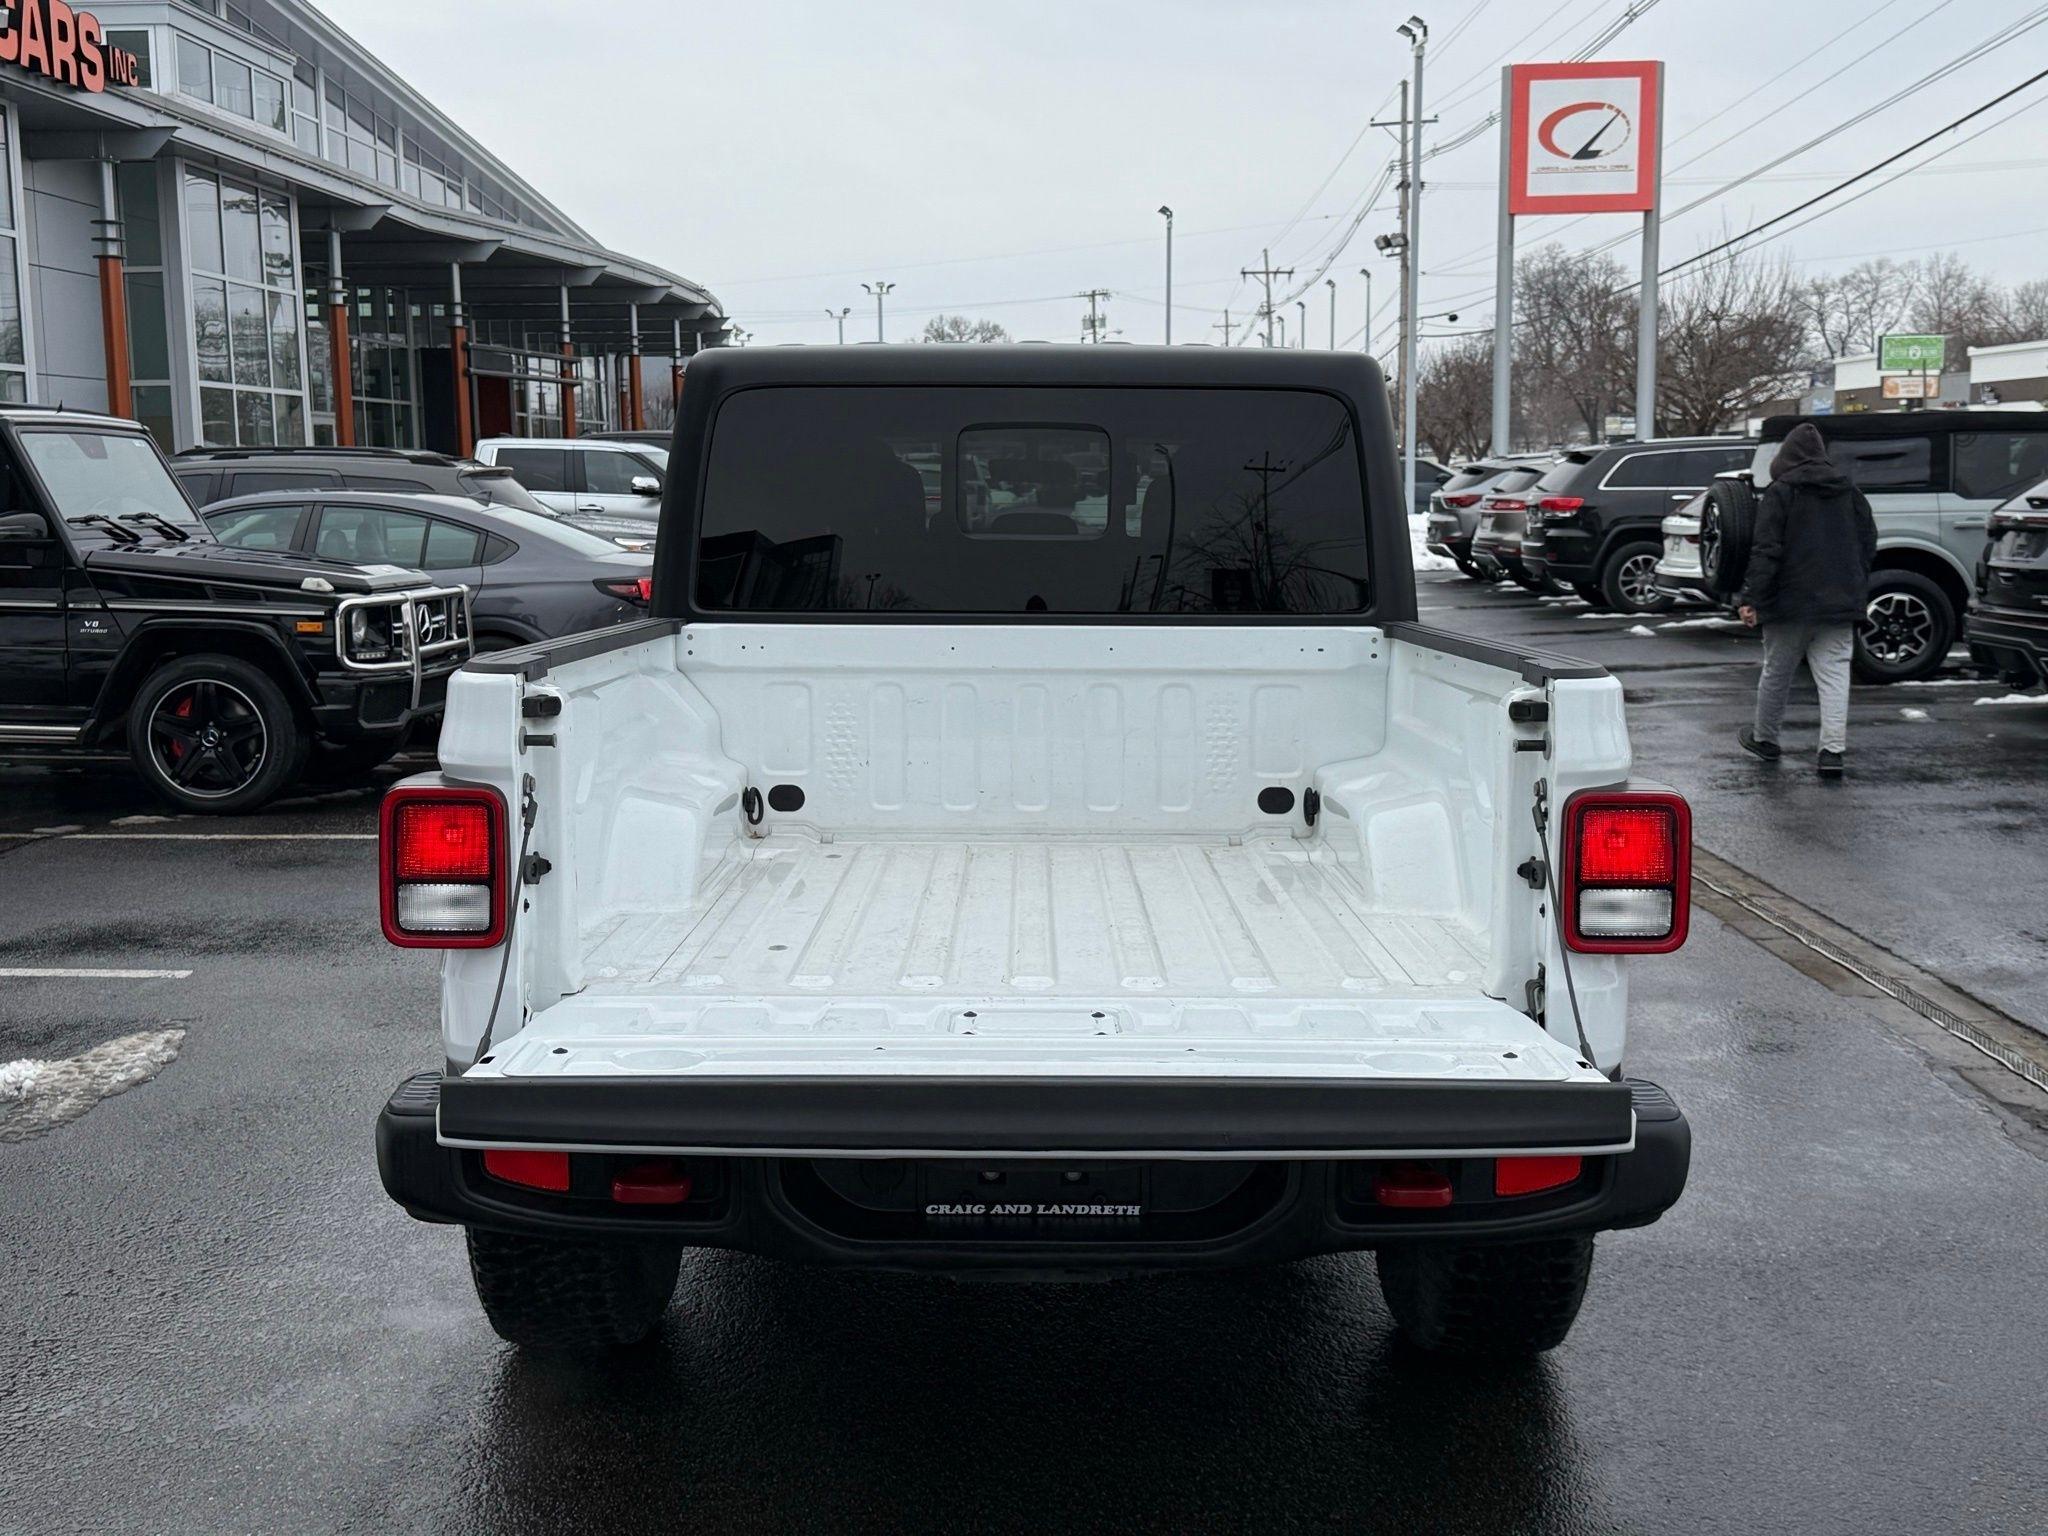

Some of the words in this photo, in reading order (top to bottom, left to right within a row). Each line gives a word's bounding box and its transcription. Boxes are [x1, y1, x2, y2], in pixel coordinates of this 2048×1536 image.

[108, 45, 138, 87] INC
[84, 620, 99, 628] V8
[925, 1204, 986, 1215] CRAIG
[990, 1204, 1032, 1215] AND
[1037, 1204, 1141, 1216] LANDRETH
